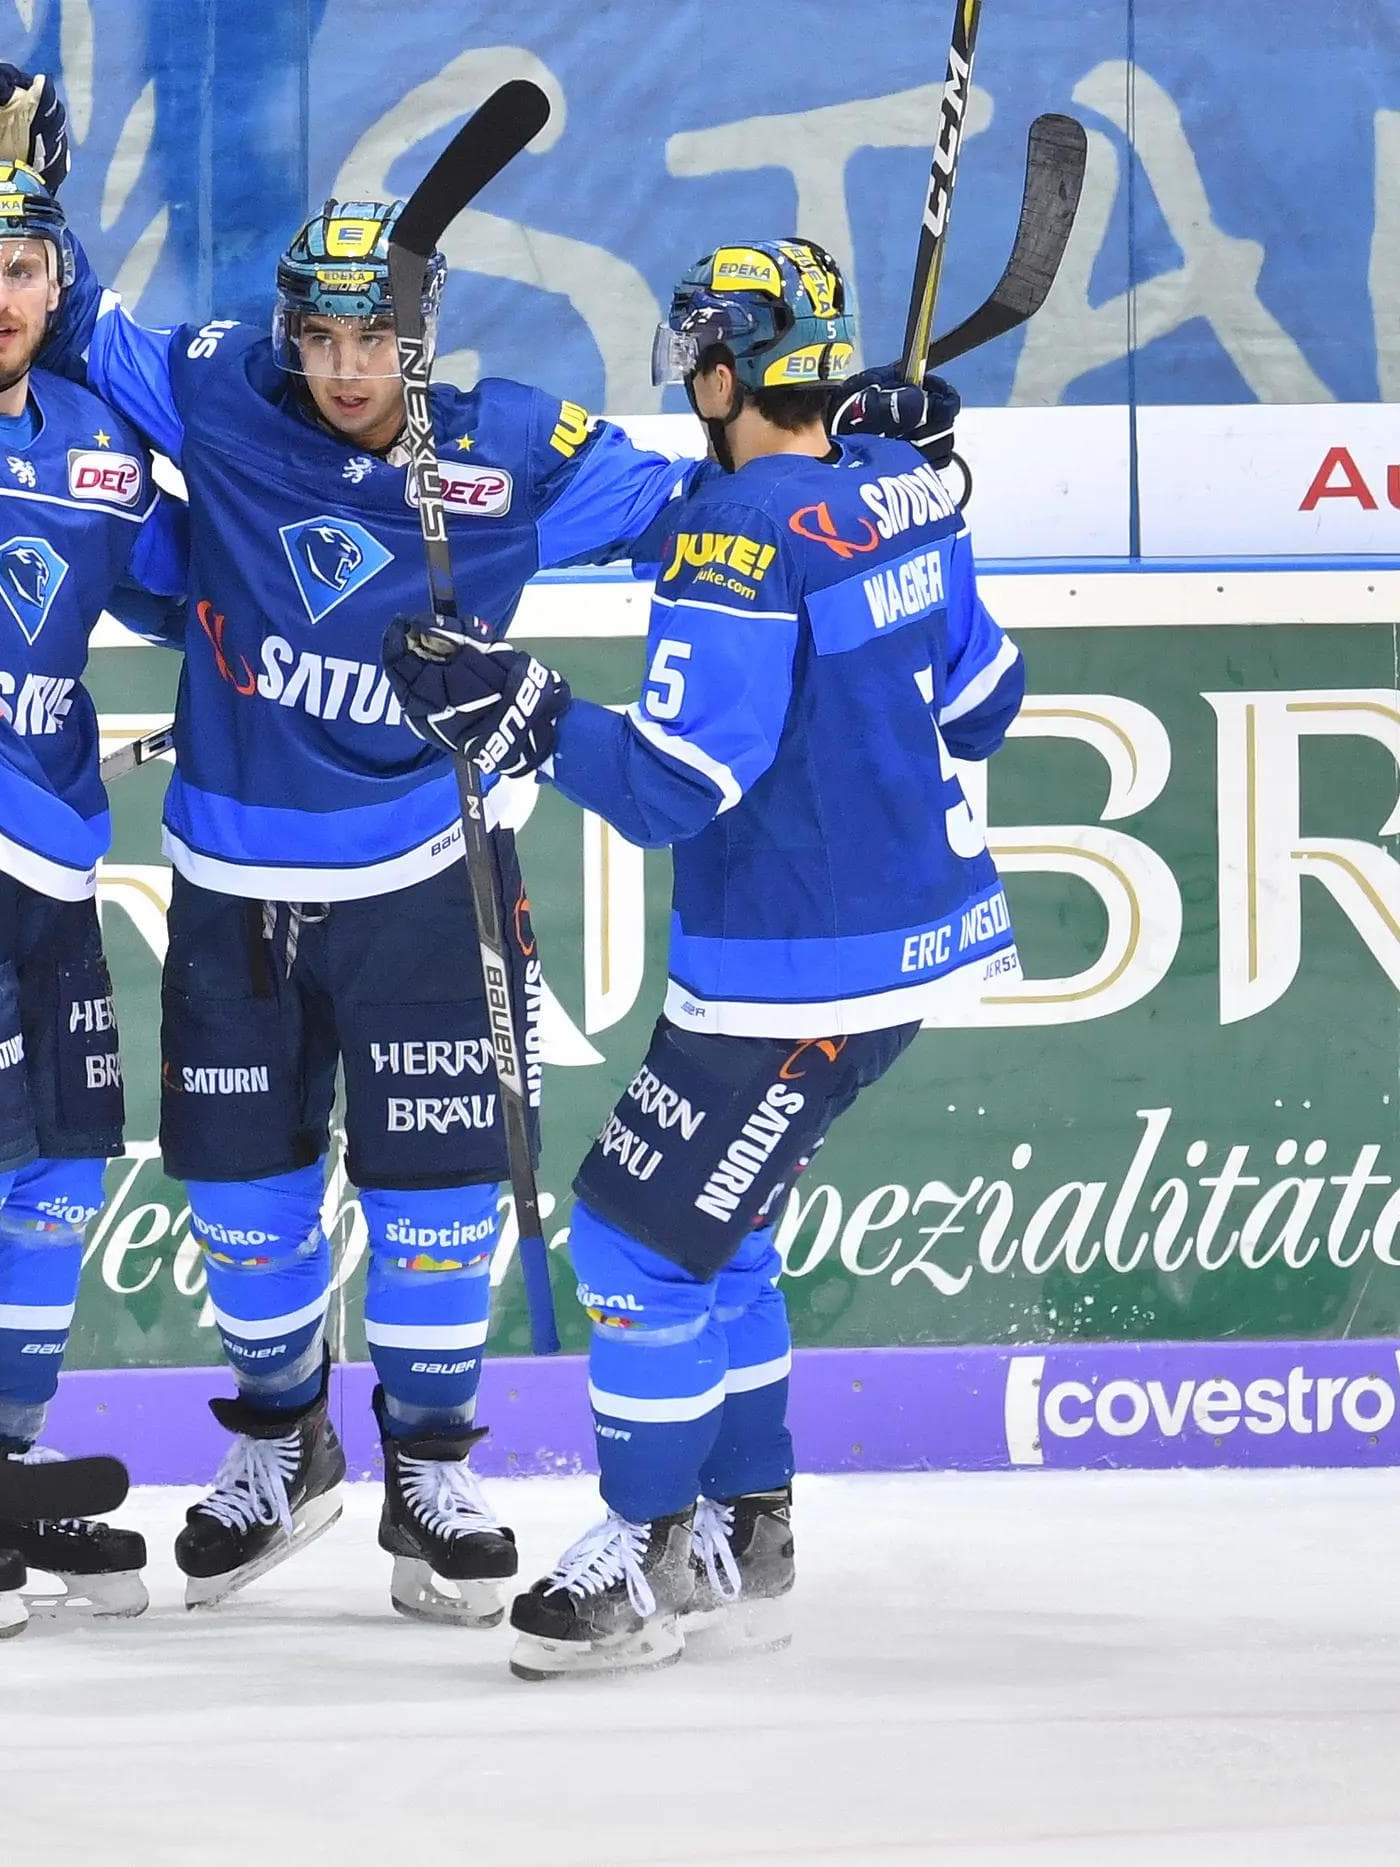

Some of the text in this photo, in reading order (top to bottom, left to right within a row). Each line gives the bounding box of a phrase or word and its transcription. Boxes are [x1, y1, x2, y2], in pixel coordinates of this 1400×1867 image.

[923, 48, 969, 238] CCM
[324, 272, 365, 281] EDEKA
[718, 263, 771, 279] EDEKA
[826, 321, 837, 339] 5
[397, 337, 448, 541] NEXUS
[75, 467, 137, 496] DEL
[663, 533, 777, 582] JUKE!
[645, 639, 693, 720] 5
[473, 656, 550, 775] BAUER
[901, 925, 951, 973] ERC
[486, 965, 515, 1076] BAUER
[182, 1066, 269, 1094] SATURN
[627, 1064, 707, 1141] ERRN
[387, 1094, 496, 1133] BRÄU
[695, 1083, 805, 1223] SATURN
[411, 1358, 476, 1374] BAUER
[1044, 1366, 1396, 1438] covestro
